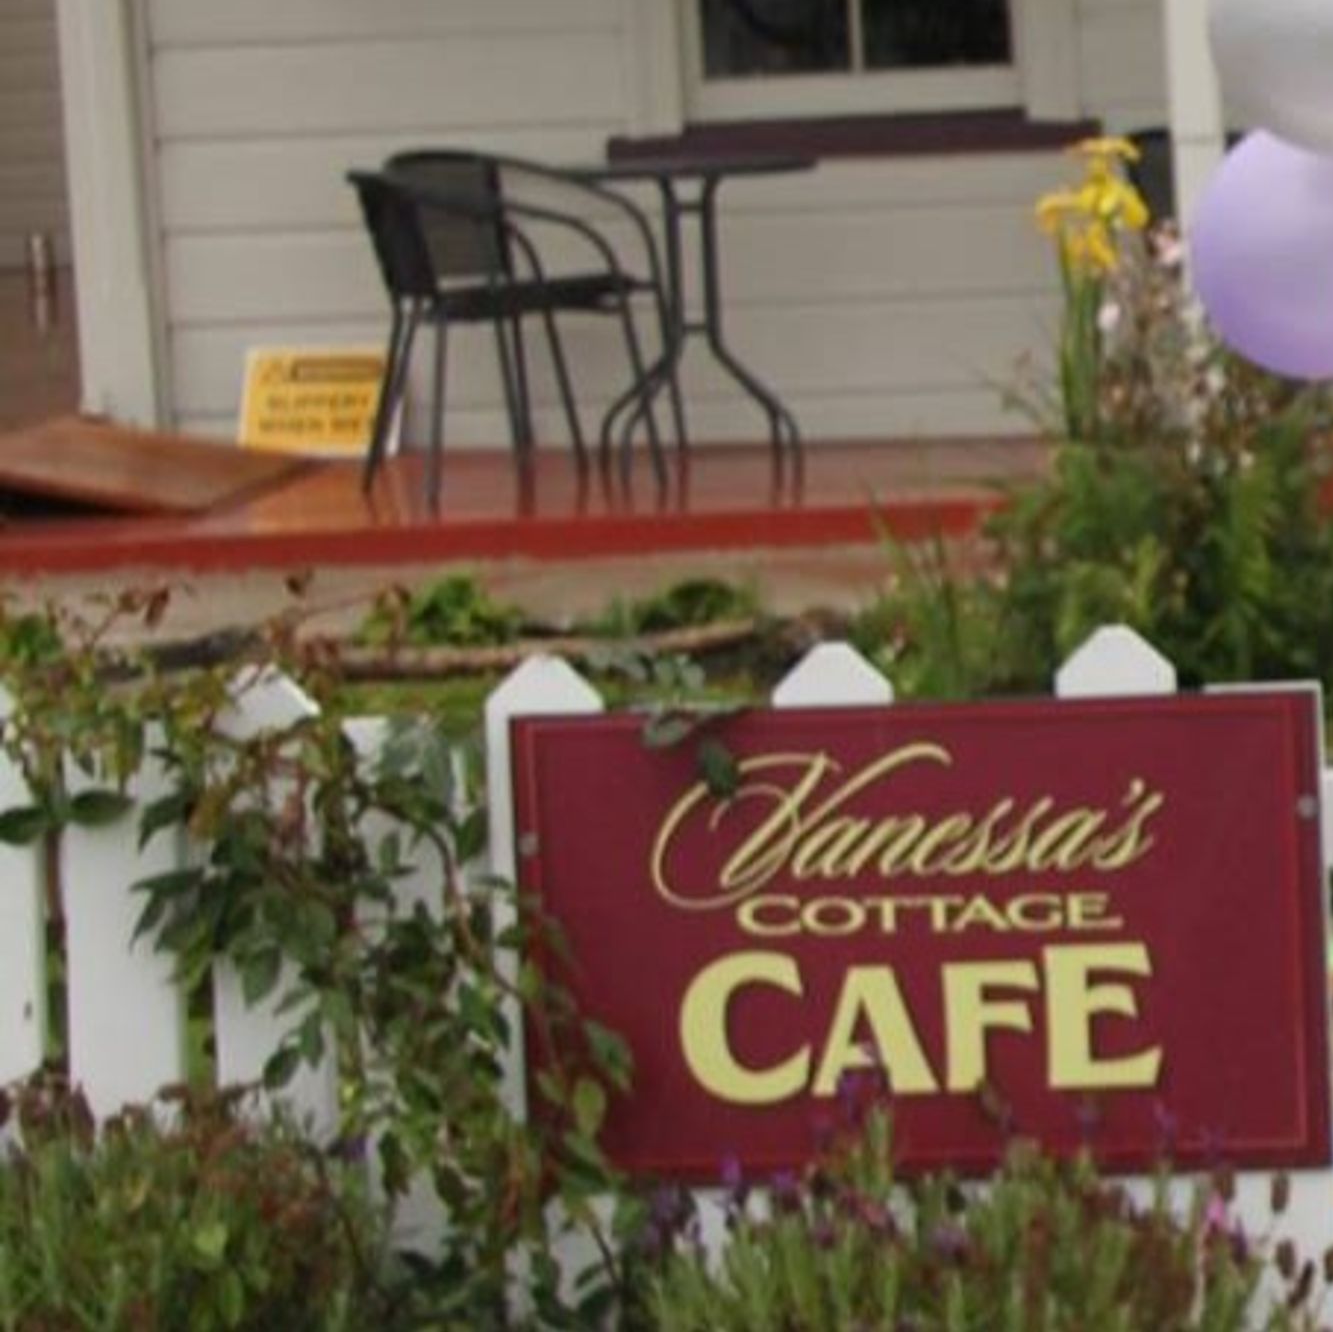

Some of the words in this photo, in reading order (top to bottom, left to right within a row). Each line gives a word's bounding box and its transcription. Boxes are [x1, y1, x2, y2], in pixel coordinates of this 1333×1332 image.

[652, 743, 1164, 909] Vanessa's
[736, 891, 1124, 937] COTTAGE
[679, 941, 1164, 1105] CAFE
